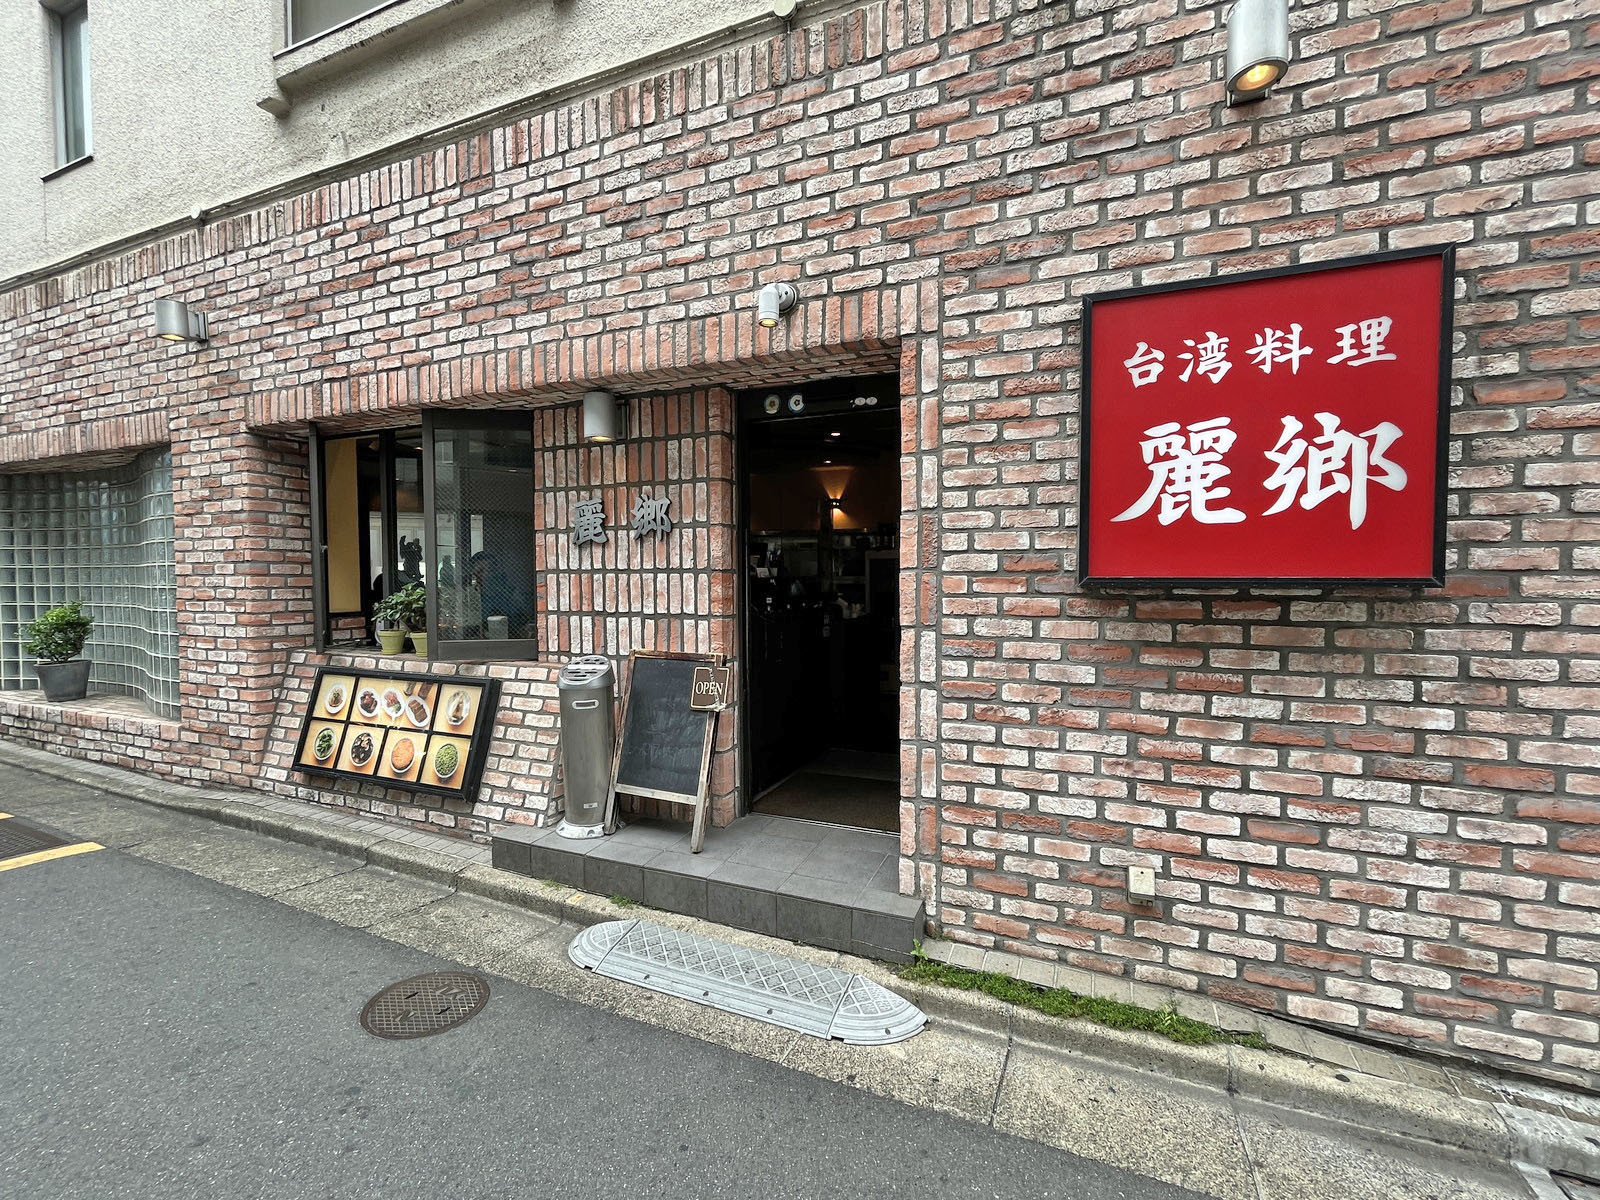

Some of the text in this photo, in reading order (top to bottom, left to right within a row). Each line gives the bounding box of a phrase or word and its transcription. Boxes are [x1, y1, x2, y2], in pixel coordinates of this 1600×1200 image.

[1123, 316, 1398, 389] 台湾料理
[695, 681, 724, 695] OPEN
